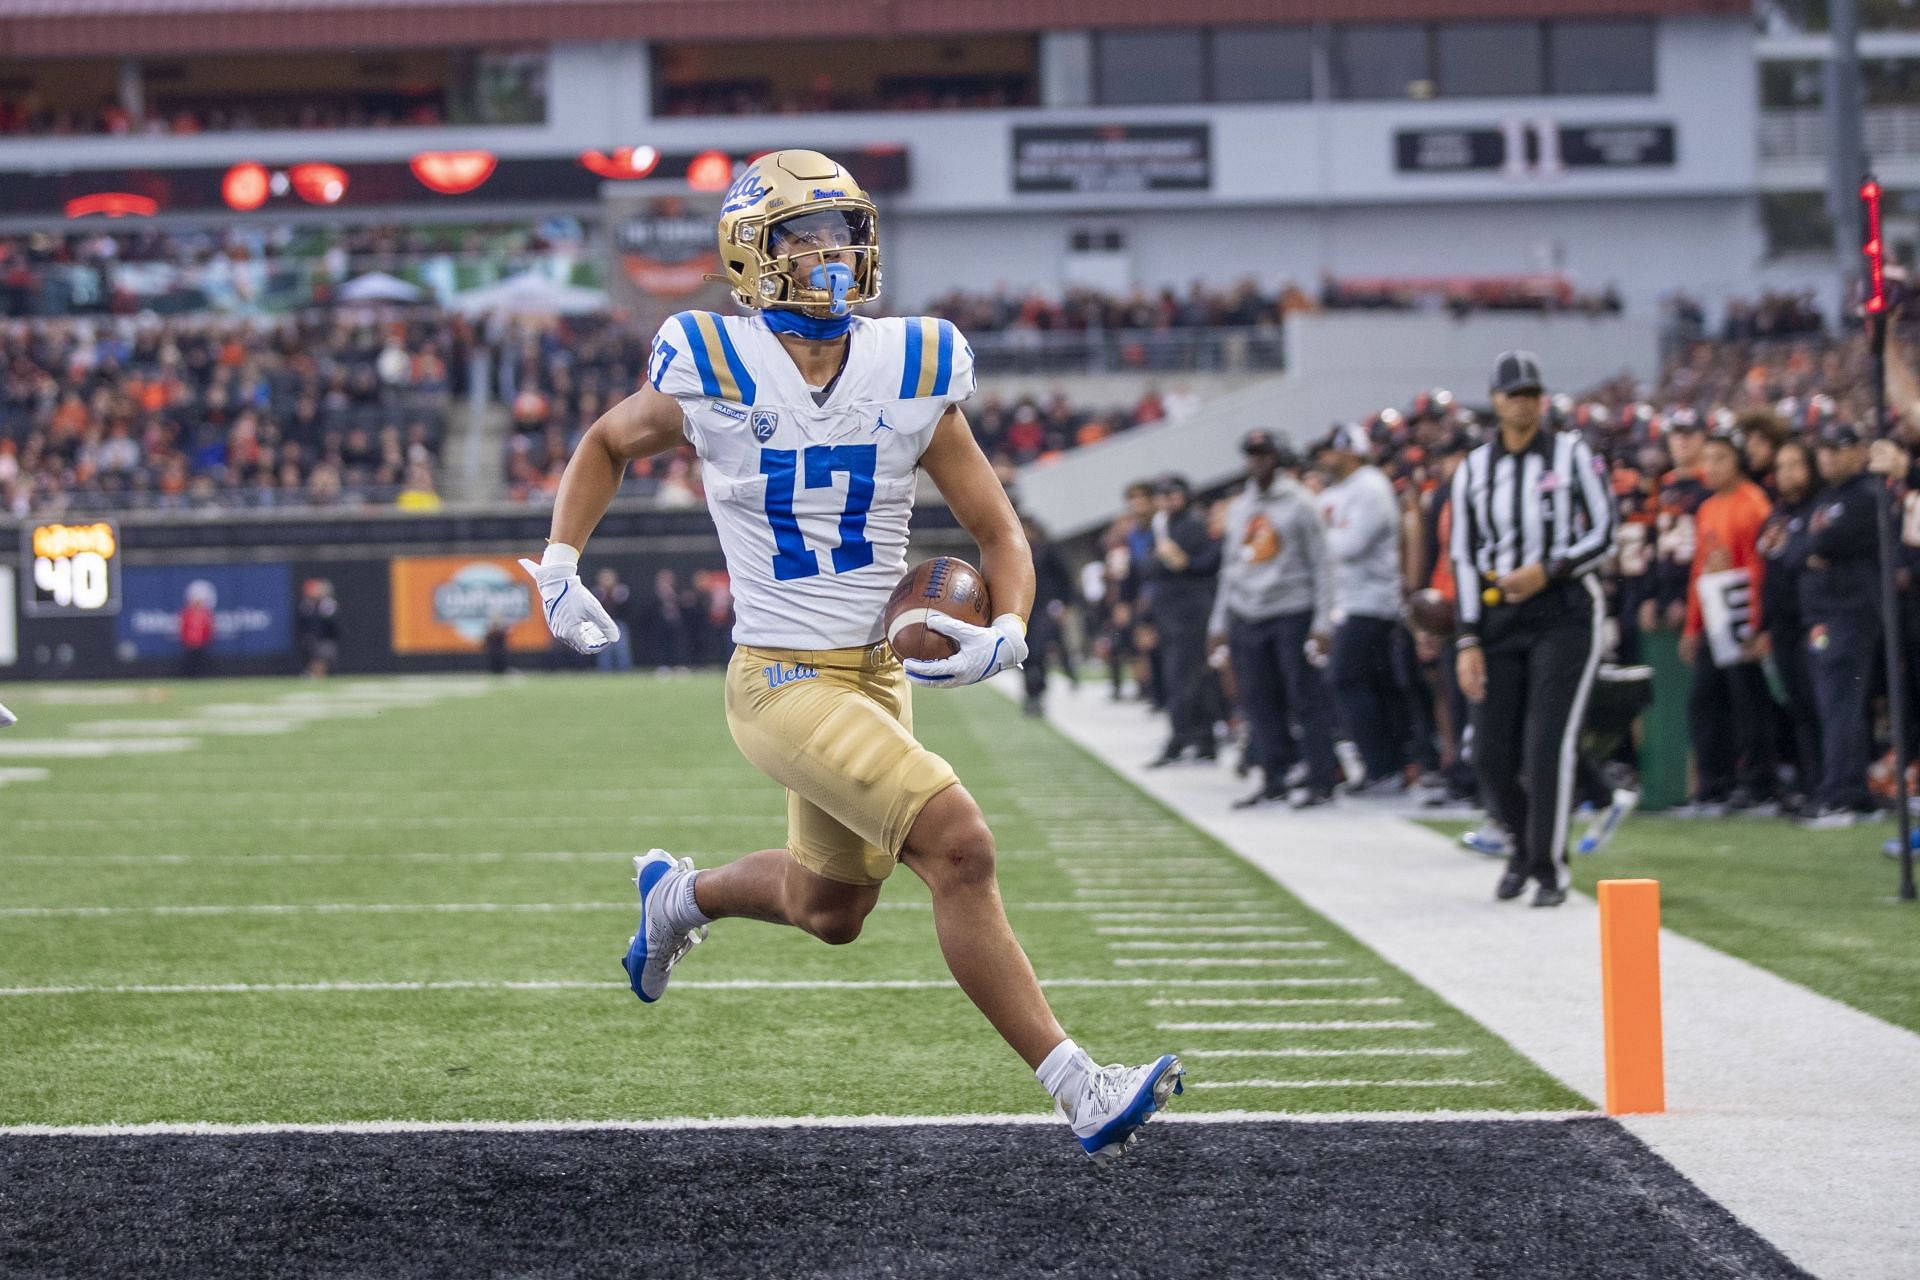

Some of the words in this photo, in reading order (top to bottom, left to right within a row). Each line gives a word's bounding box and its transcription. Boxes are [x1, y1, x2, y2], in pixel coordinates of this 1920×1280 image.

[757, 424, 770, 436] 12
[760, 443, 877, 581] 17
[34, 552, 108, 609] 40
[763, 662, 818, 689] Ucla
